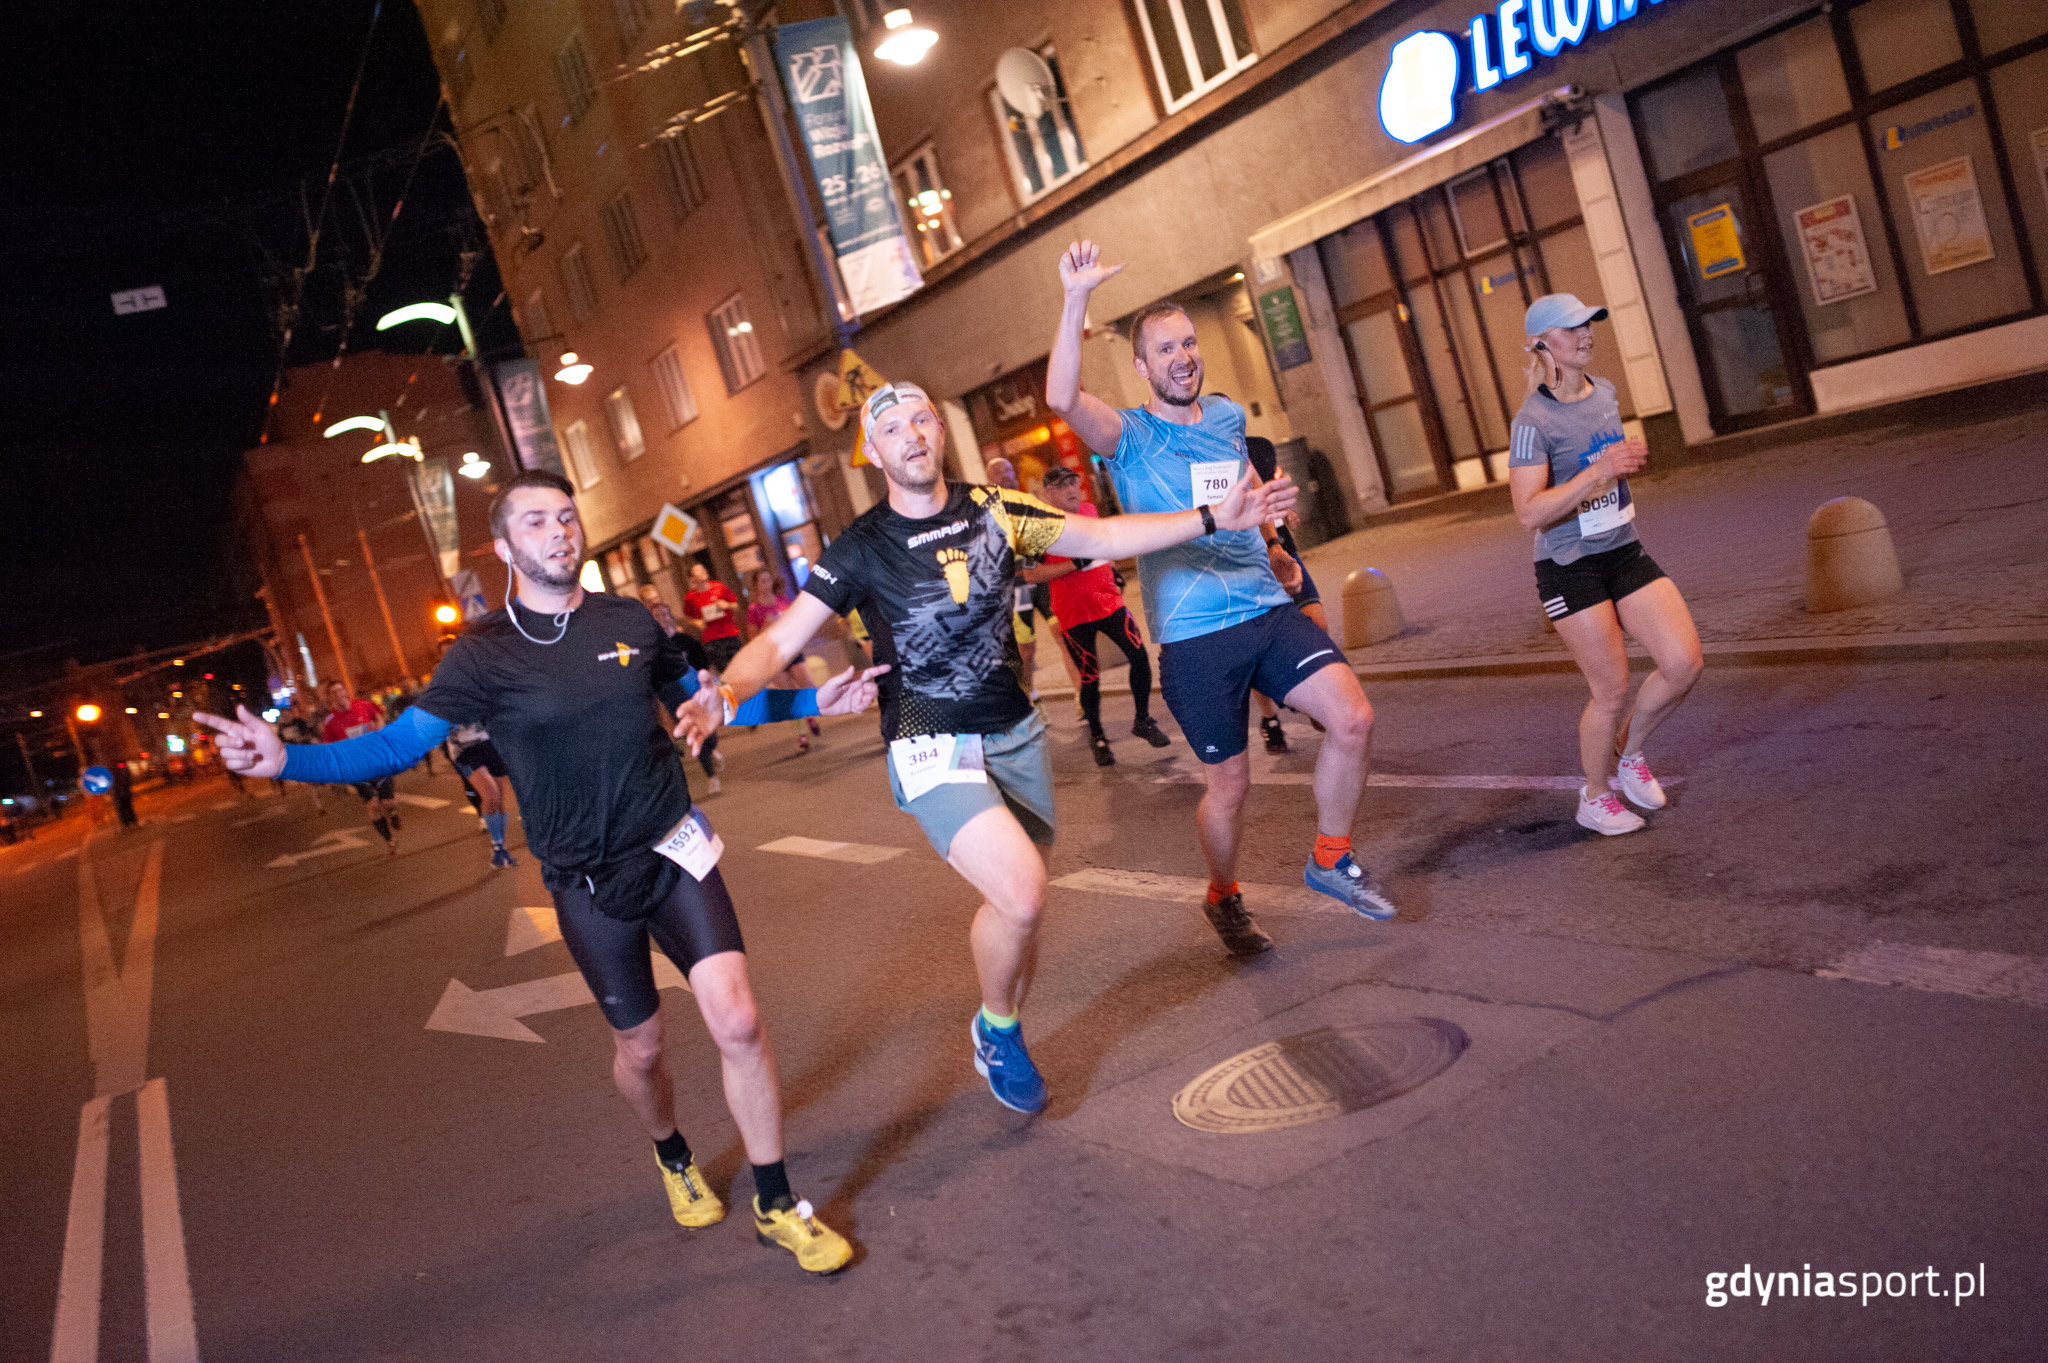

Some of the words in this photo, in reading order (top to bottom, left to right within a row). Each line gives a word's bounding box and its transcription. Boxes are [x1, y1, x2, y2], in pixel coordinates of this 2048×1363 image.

[1469, 0, 1664, 93] LEW
[820, 174, 847, 197] 25
[1203, 478, 1228, 491] 780
[1580, 491, 1618, 514] 9090
[907, 518, 970, 549] SMMASH
[908, 747, 939, 767] 384
[667, 823, 697, 853] 1592
